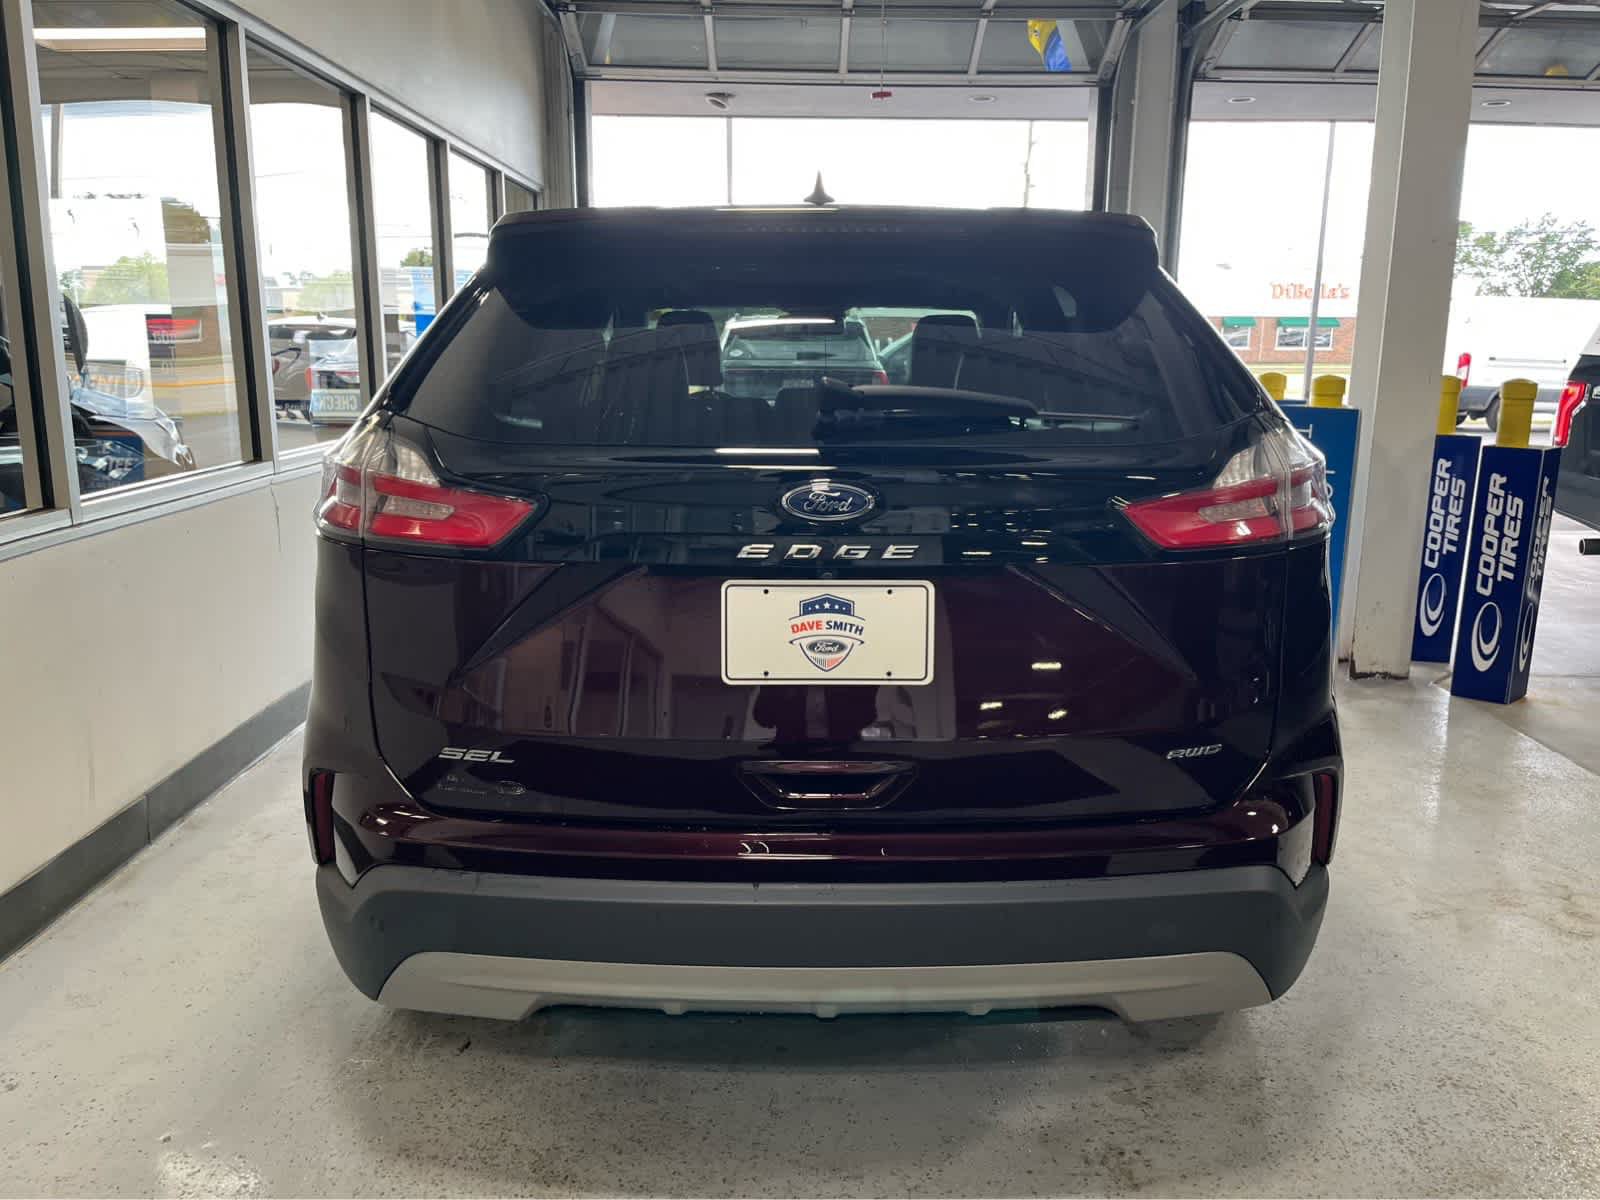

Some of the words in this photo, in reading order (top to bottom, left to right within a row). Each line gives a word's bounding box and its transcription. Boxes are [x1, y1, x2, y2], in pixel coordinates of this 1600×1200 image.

[1271, 282, 1351, 300] DiBela's
[803, 489, 852, 512] Ford
[1424, 457, 1452, 569] COOPER
[1442, 476, 1466, 555] TIRES
[1476, 472, 1507, 597] COOPER
[1496, 496, 1523, 582] TIRES
[735, 543, 920, 560] EDGE
[791, 620, 823, 634] DAVE
[825, 620, 865, 636] SMITH
[814, 640, 840, 653] Ford
[438, 746, 516, 764] SEL
[1166, 743, 1223, 760] AWD
